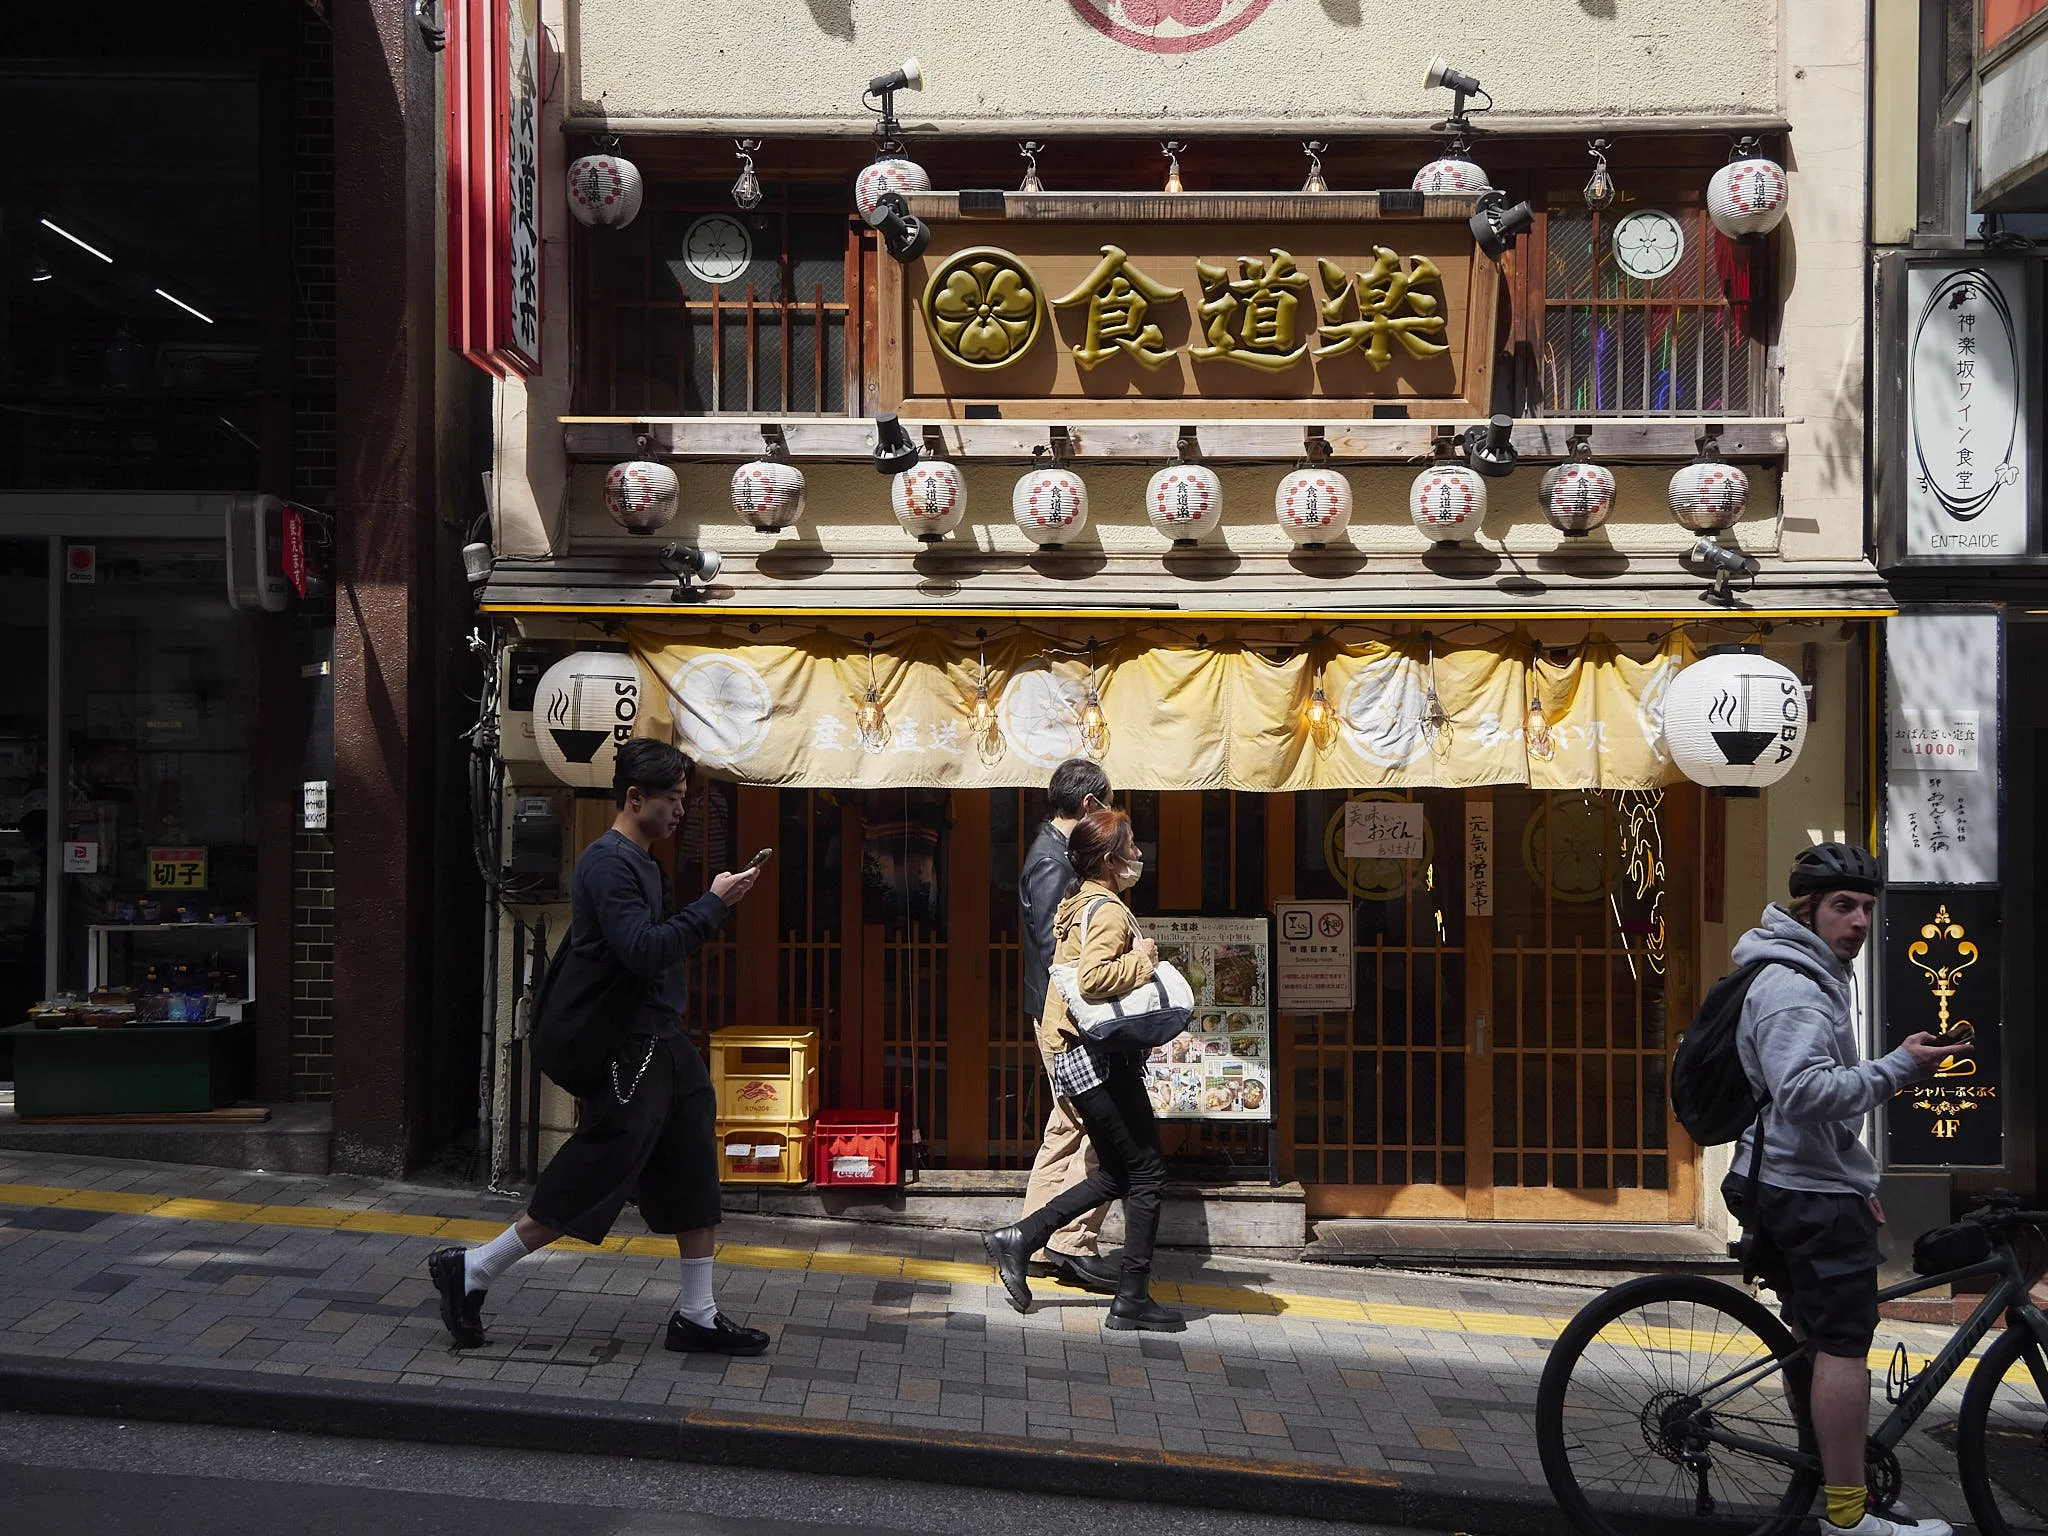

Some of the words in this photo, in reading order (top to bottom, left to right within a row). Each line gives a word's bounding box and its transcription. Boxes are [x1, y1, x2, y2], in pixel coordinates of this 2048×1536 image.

[517, 37, 538, 346] 食道楽
[1752, 171, 1766, 208] 食道楽
[1050, 244, 1450, 373] 食道楽
[1956, 313, 1976, 490] 神楽坂ワイン食堂
[742, 476, 755, 511] 食道楽
[925, 476, 939, 514] 食道楽
[1050, 485, 1063, 524] 食道楽
[1176, 480, 1190, 519] 食道楽
[1305, 485, 1319, 523] 食道楽
[1438, 483, 1452, 521] 食道楽
[1576, 476, 1589, 512] 食道楽
[1931, 533, 2000, 549] ENTRAIDE
[1774, 682, 1799, 765] SOBA
[1895, 728, 1976, 741] おばんざい定食
[1915, 743, 1955, 755] 1000
[1958, 748, 1967, 756] 円
[1346, 804, 1405, 828] 美味しい
[1367, 821, 1414, 840] おでん
[153, 863, 202, 886] 切子
[1468, 815, 1489, 916] 元気に営業中
[1931, 1119, 1960, 1138] 4F
